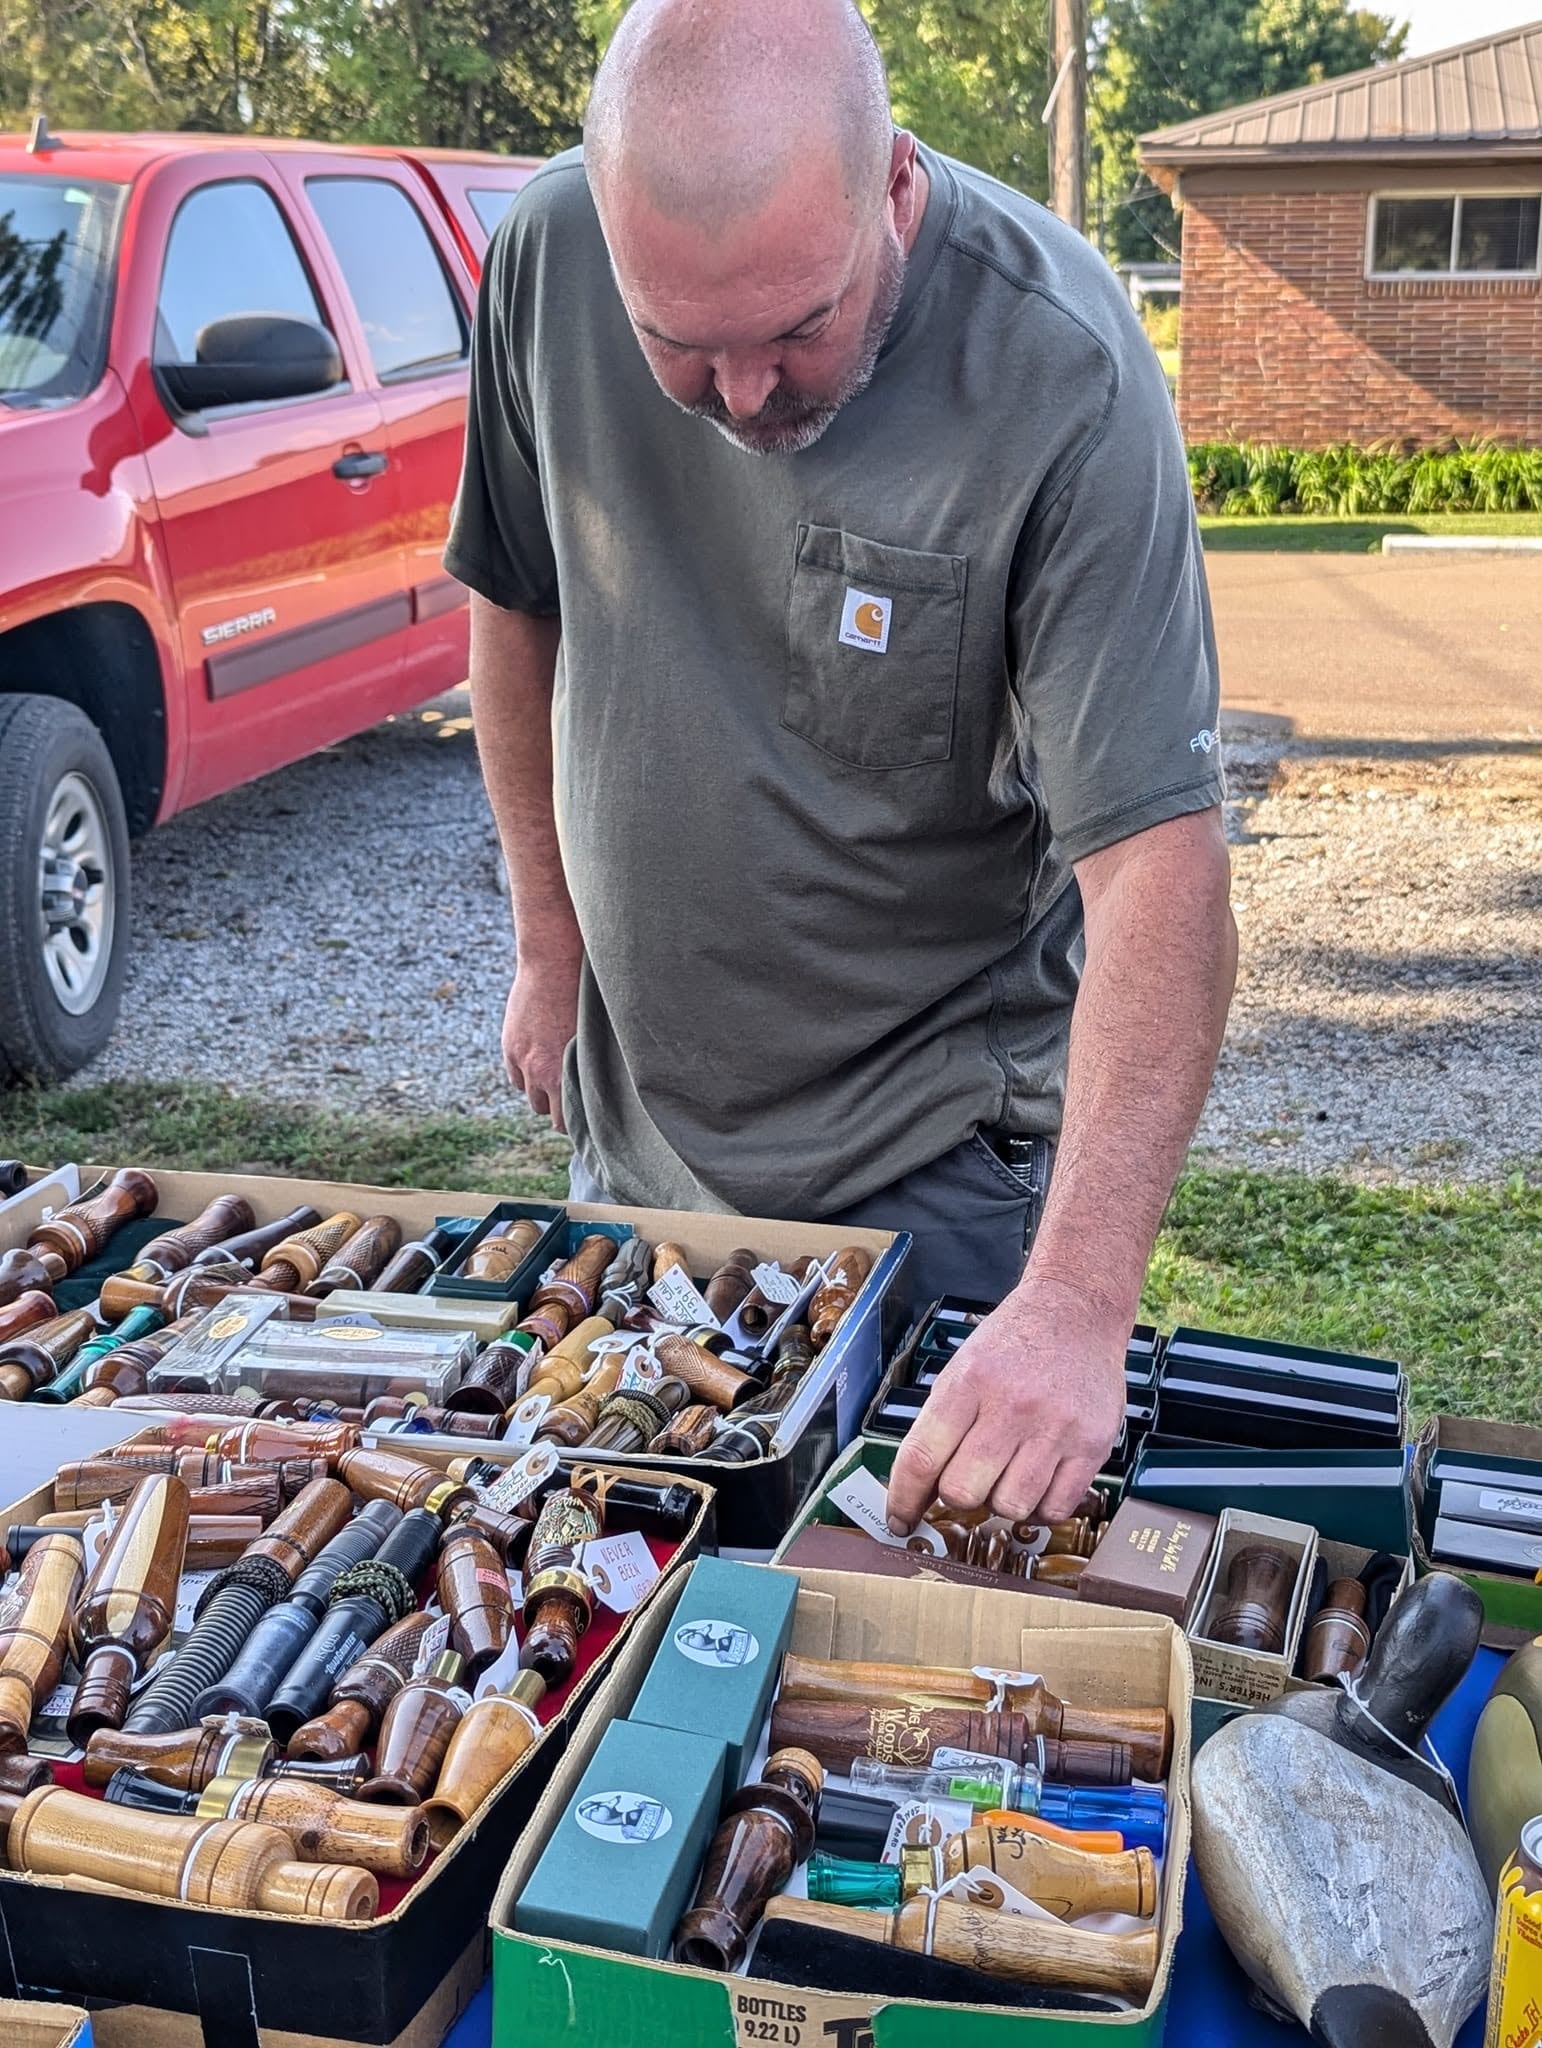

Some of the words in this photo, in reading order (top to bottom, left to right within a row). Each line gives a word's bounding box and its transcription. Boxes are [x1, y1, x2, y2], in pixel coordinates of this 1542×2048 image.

[200, 606, 276, 646] SIERRA
[845, 631, 881, 647] carhartt
[656, 1280, 673, 1301] CALL
[600, 1541, 634, 1564] NEVER
[617, 1562, 642, 1582] BEEN
[1219, 1681, 1271, 1702] HERTER'S
[882, 1708, 909, 1763] WOODS
[737, 1994, 807, 2023] BOTTLES
[744, 2019, 779, 2042] 9.22
[784, 2025, 801, 2047] L)
